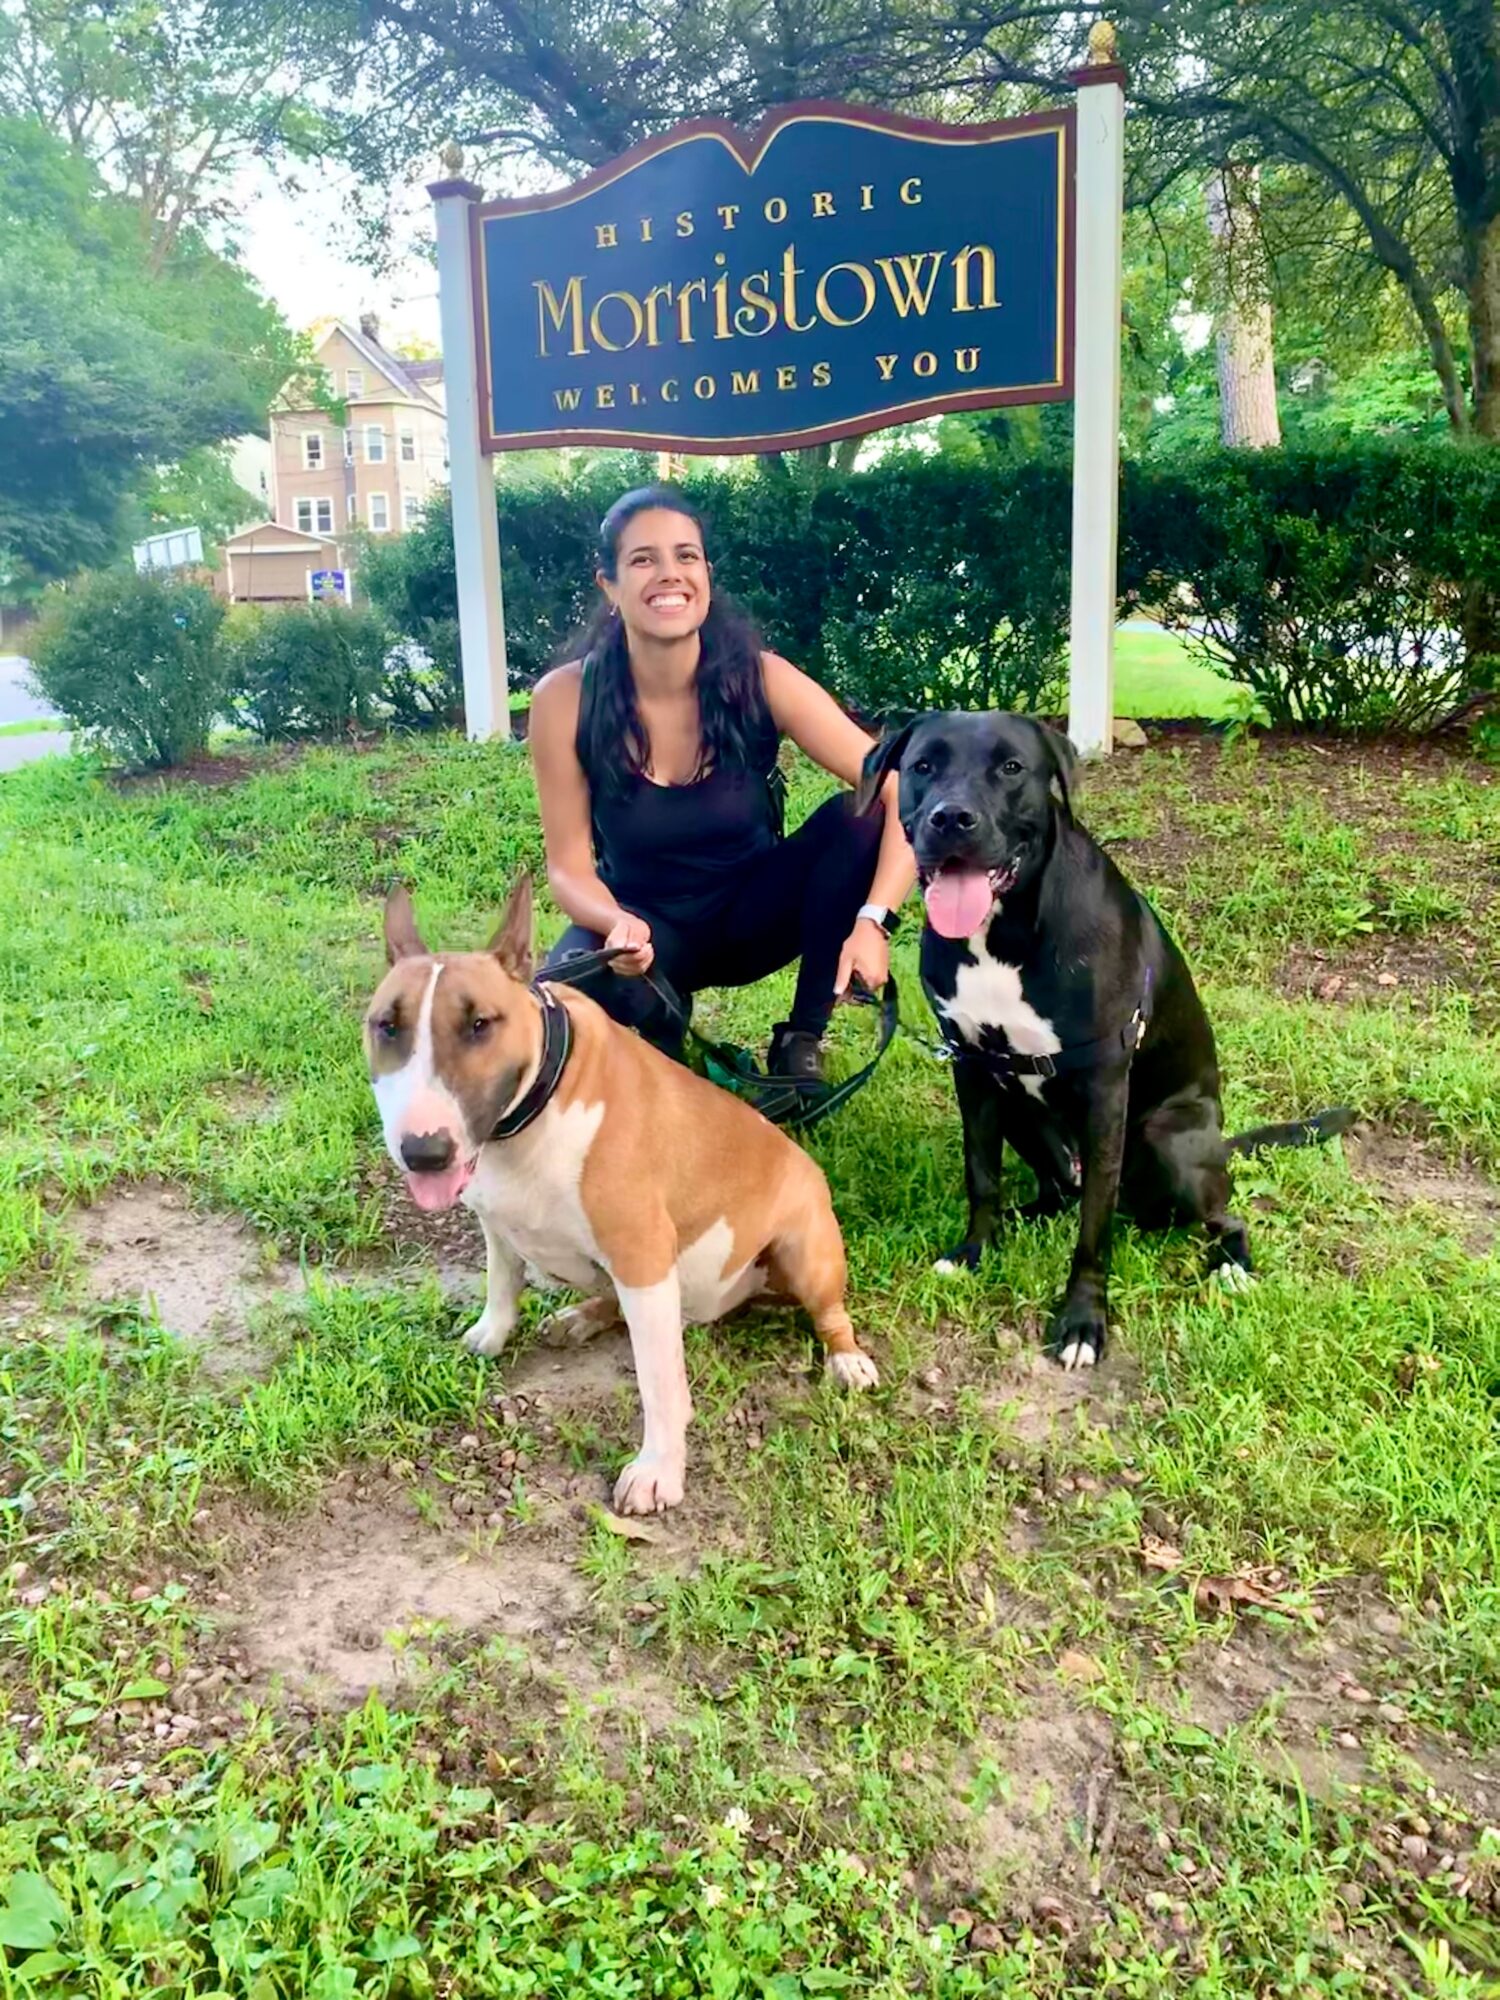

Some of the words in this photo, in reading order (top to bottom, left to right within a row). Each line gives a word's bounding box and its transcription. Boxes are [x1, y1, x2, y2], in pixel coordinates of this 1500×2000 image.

[596, 177, 926, 249] HISTORIC
[532, 242, 1003, 358] Morristown
[553, 361, 833, 413] WELCOMES
[876, 347, 982, 381] YOU
